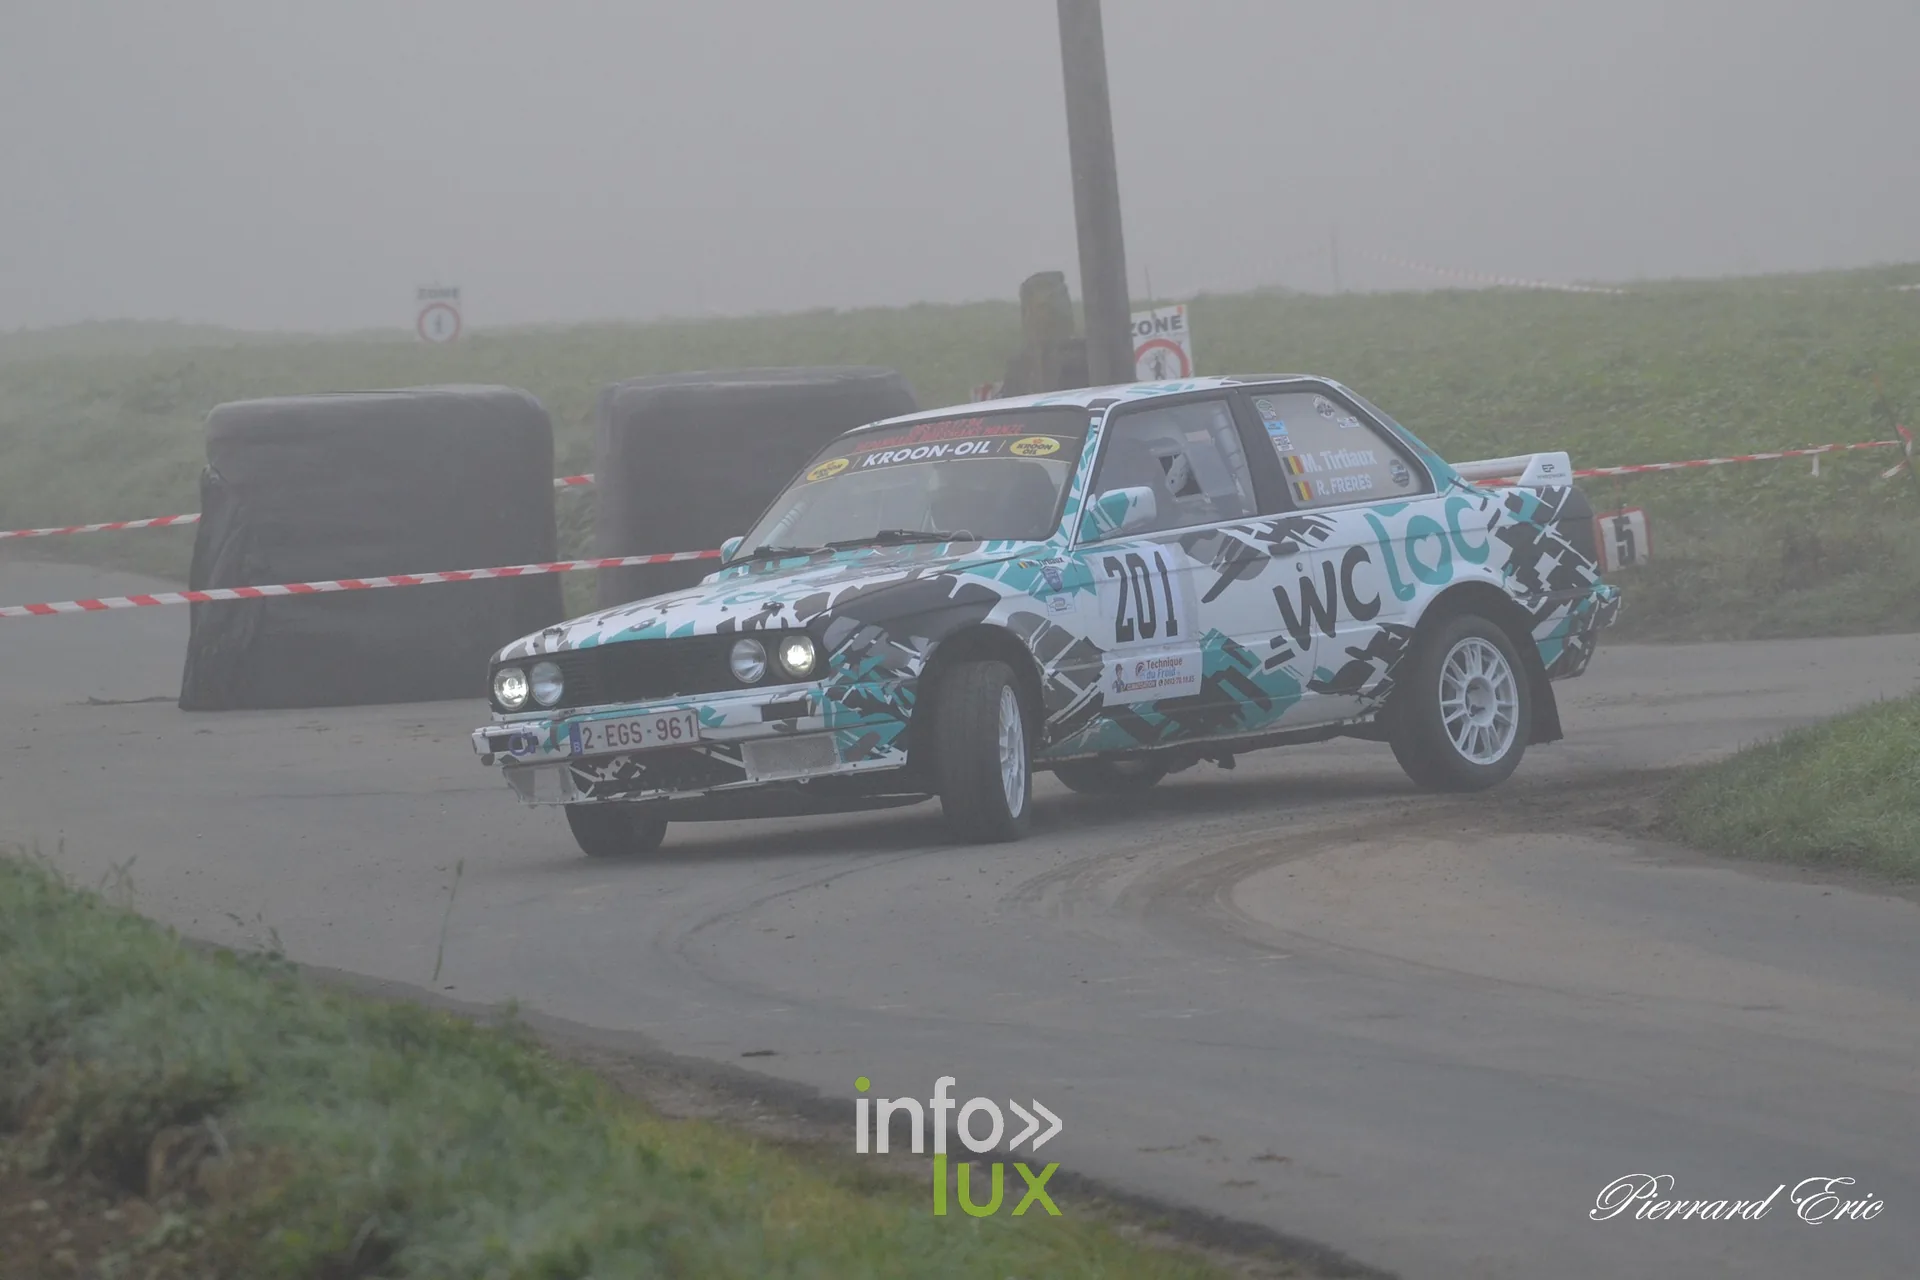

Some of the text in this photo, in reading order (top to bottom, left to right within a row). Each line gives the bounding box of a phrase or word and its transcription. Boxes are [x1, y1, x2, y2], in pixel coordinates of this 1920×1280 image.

[862, 440, 992, 468] KROON-OIL
[1300, 448, 1378, 473] M. Tirtiaux
[1316, 474, 1373, 497] R. FRERES
[1103, 551, 1178, 643] 201
[1146, 656, 1183, 669] Technique
